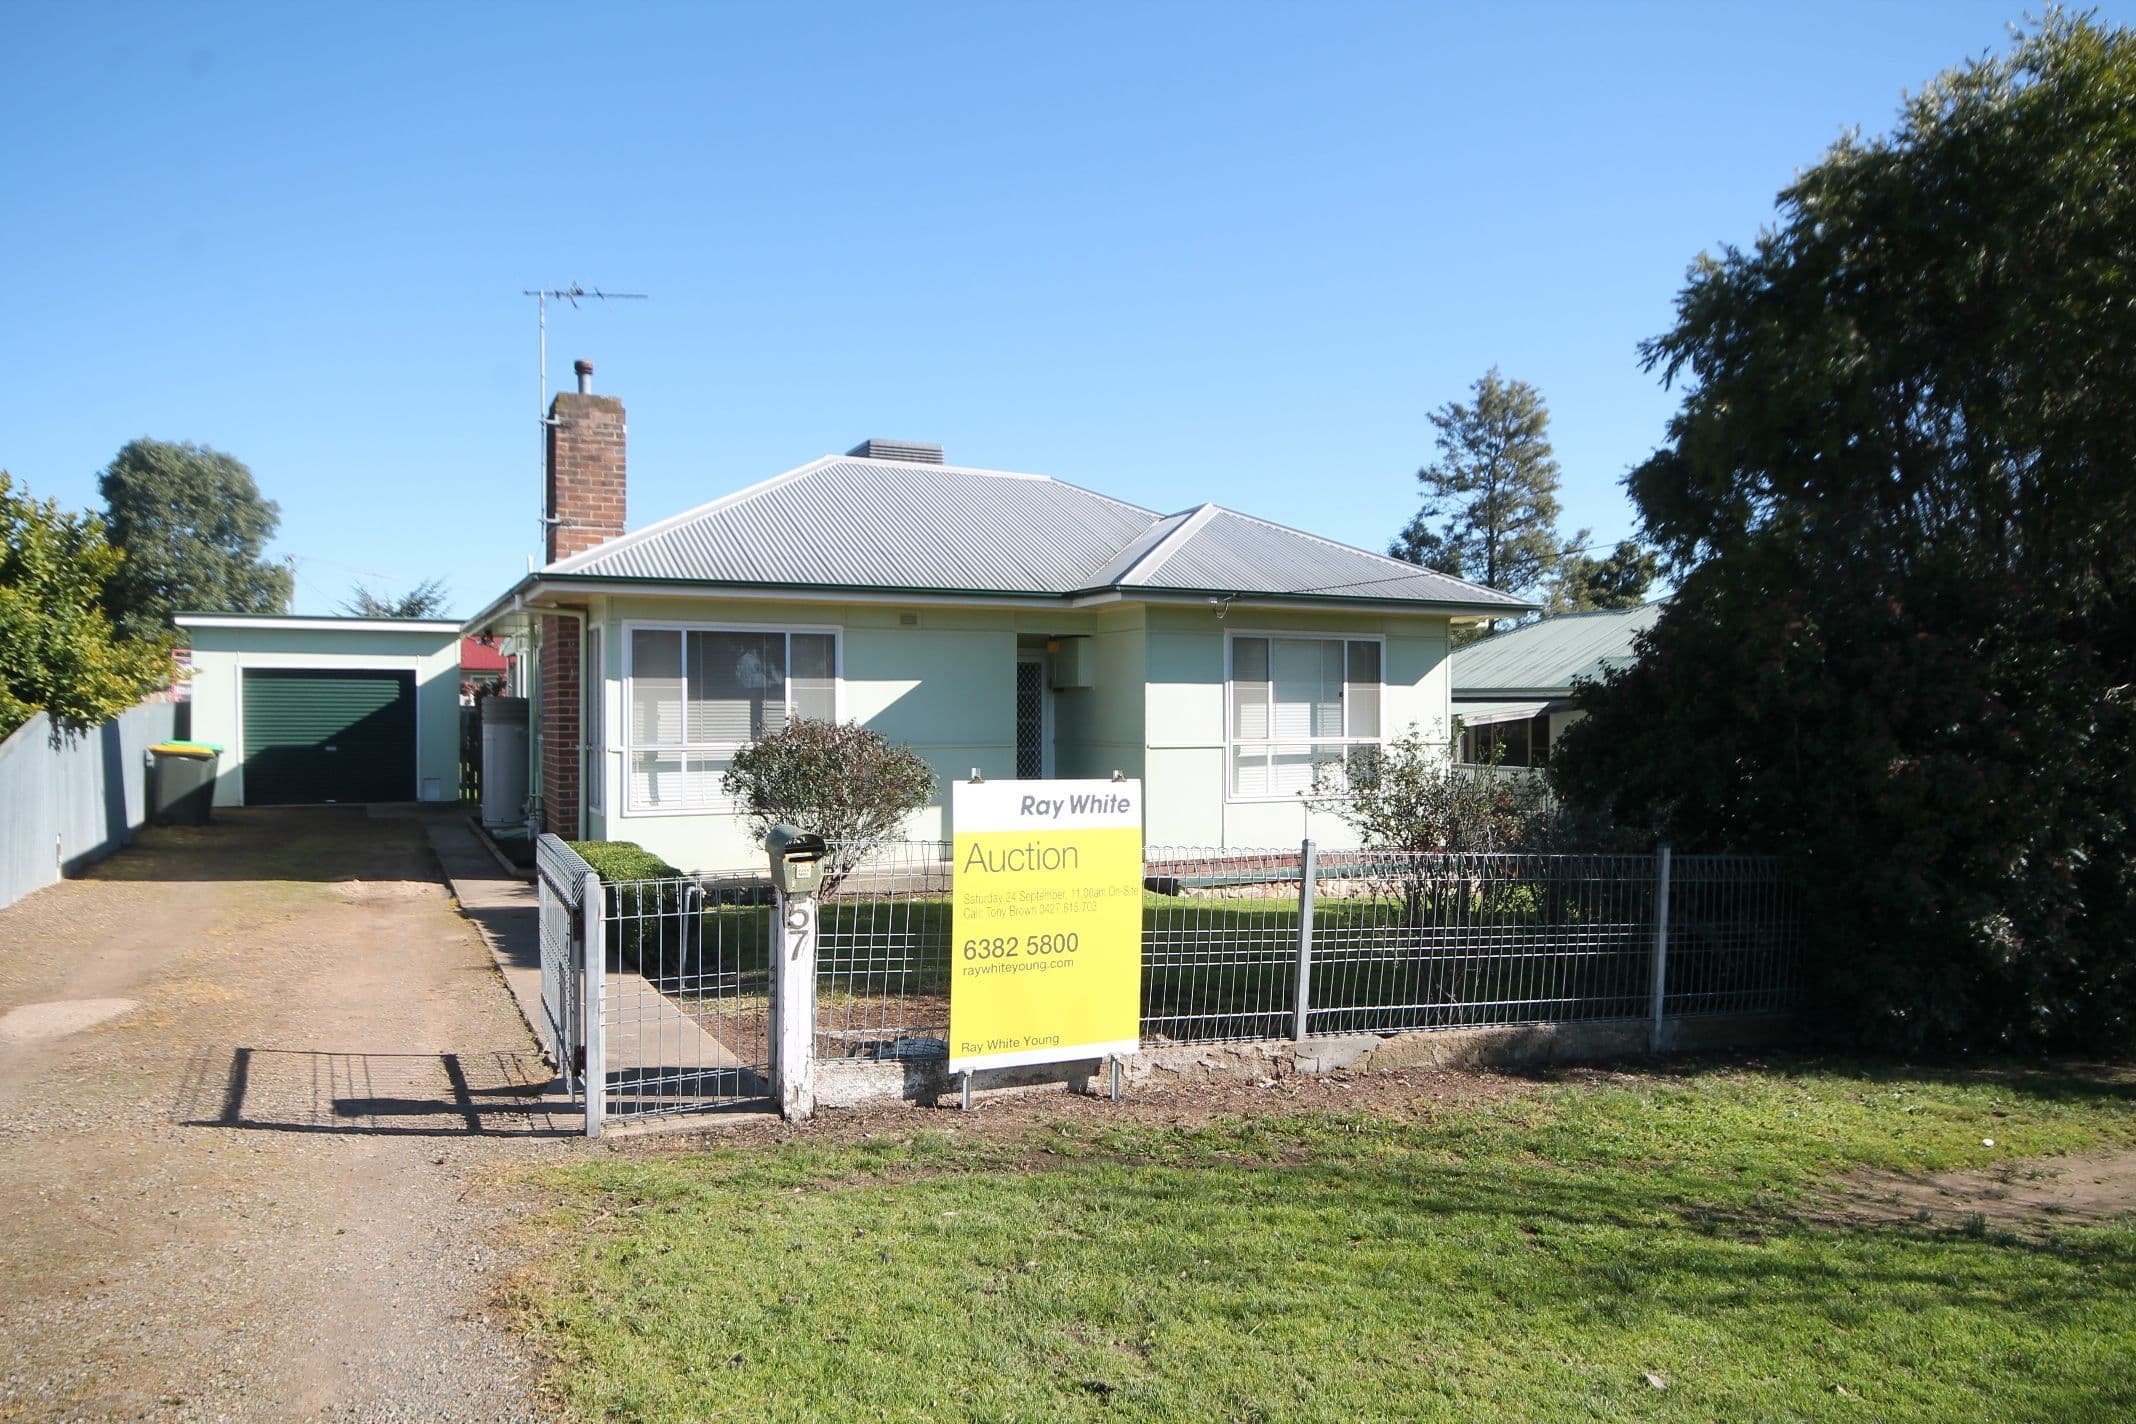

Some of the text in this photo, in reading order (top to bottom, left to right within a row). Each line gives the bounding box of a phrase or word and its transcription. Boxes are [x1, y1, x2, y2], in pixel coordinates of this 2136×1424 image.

[1020, 794, 1131, 819] Ray White
[963, 841, 1078, 873] Auction
[963, 892, 1003, 906] Saturday
[1005, 891, 1016, 903] 24
[986, 906, 1006, 919] Tony
[1010, 905, 1038, 916] Brown
[963, 932, 1079, 960] 6382 5800
[963, 959, 1074, 977] raywhiteyoung.com
[961, 1034, 1060, 1053] Ray White Young
